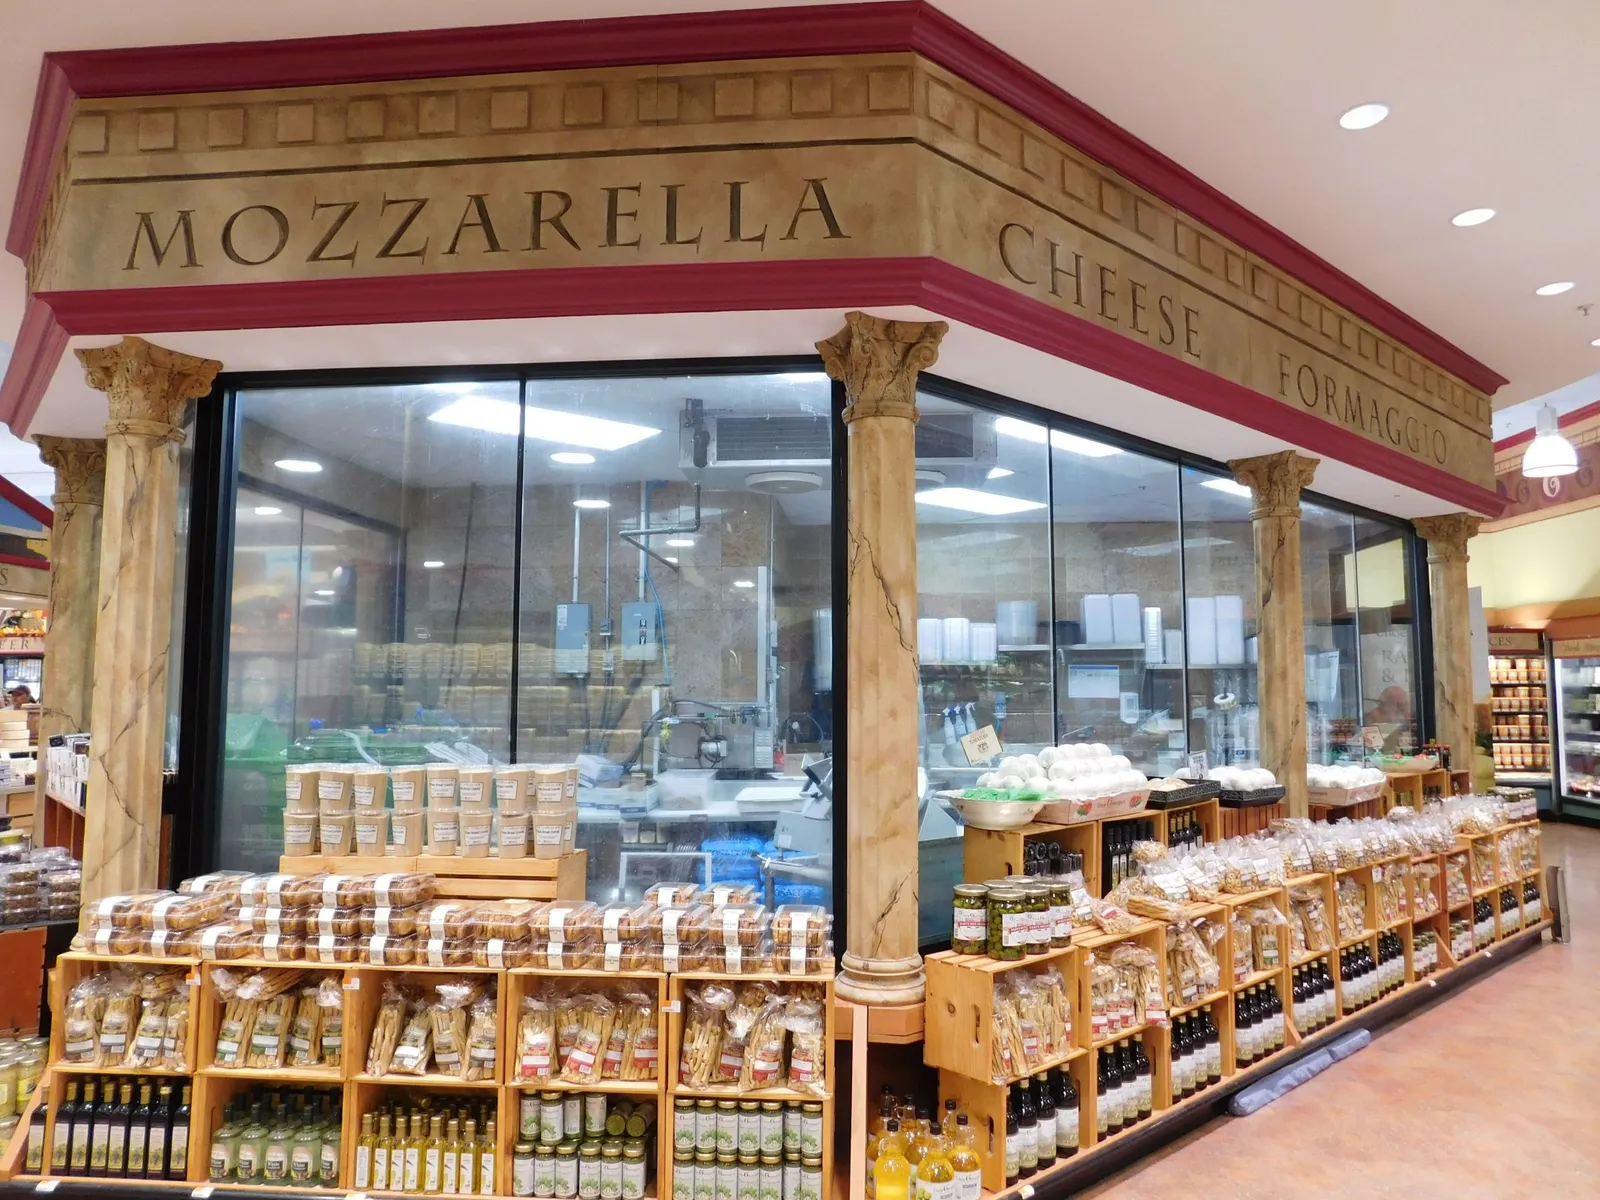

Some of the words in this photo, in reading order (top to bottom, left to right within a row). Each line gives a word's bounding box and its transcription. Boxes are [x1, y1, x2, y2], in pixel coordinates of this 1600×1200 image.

[122, 177, 851, 270] MOZZARELLA
[998, 223, 1201, 359] CHEESE
[1278, 352, 1447, 465] FORMAGGIO
